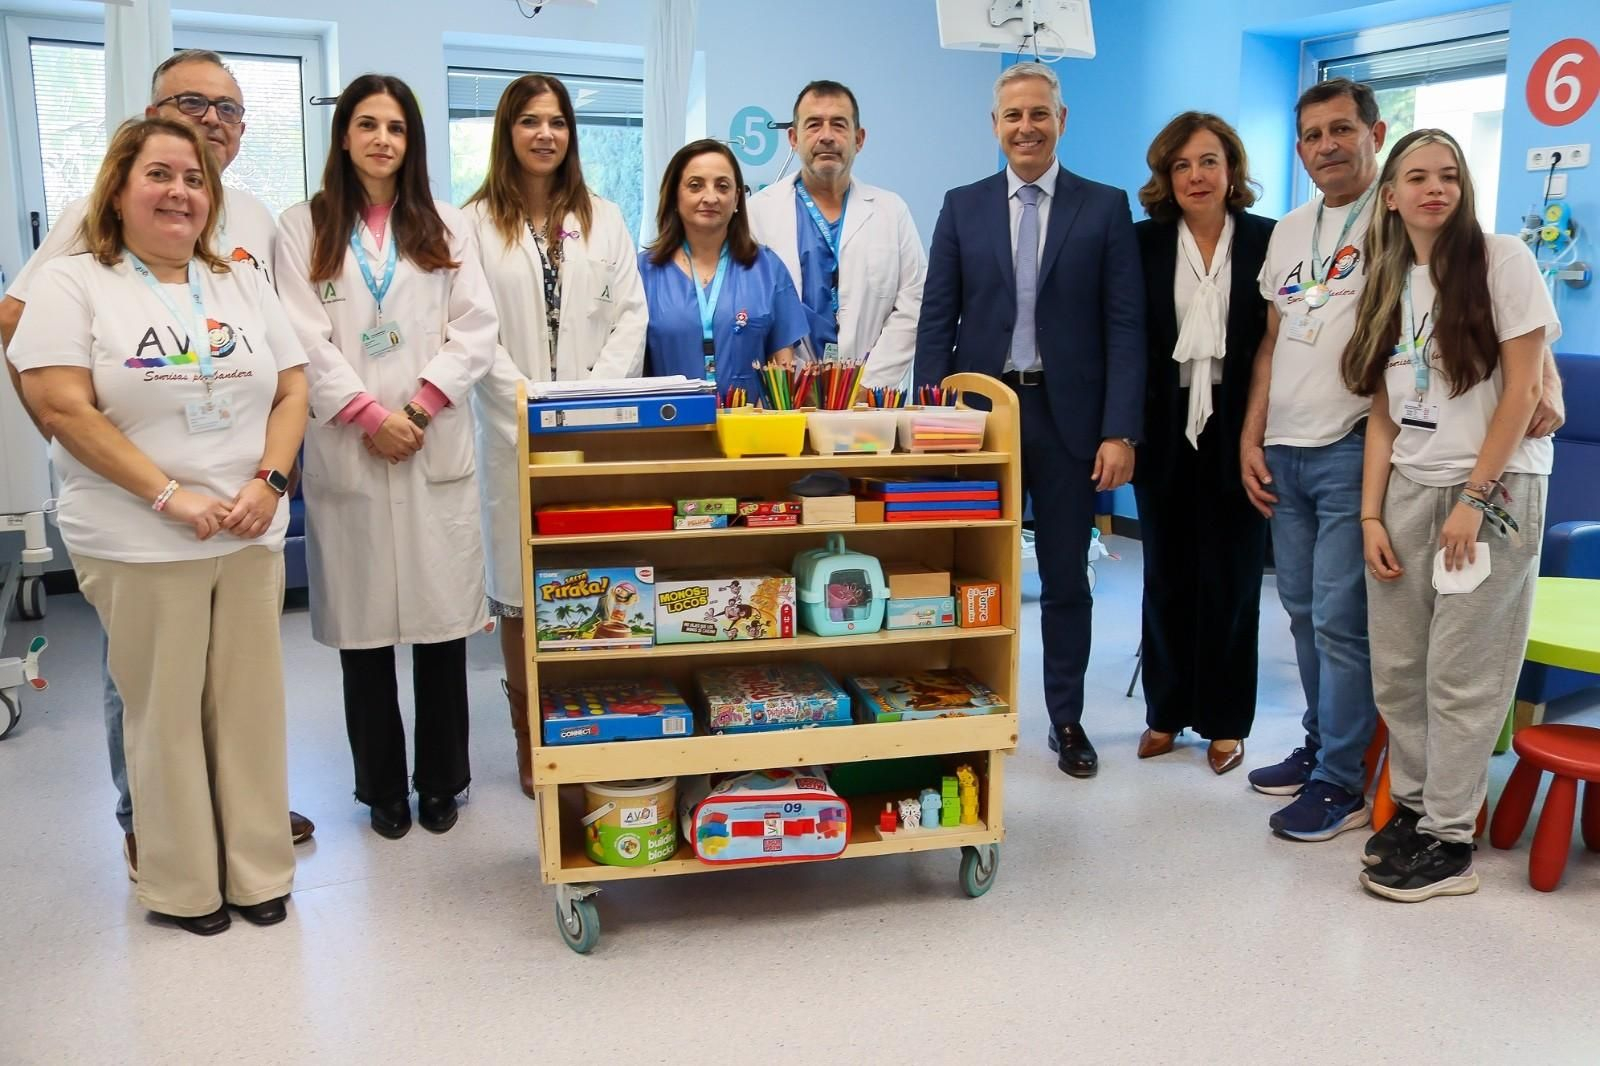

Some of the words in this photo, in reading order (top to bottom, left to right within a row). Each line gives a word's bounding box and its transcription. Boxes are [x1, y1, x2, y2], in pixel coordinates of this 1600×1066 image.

[1545, 53, 1584, 112] 6
[743, 115, 766, 156] 5
[660, 587, 701, 604] MONOS
[668, 596, 708, 613] LOCOS
[979, 587, 991, 622] Torre
[560, 727, 591, 738] CONNECT
[783, 802, 802, 814] 09
